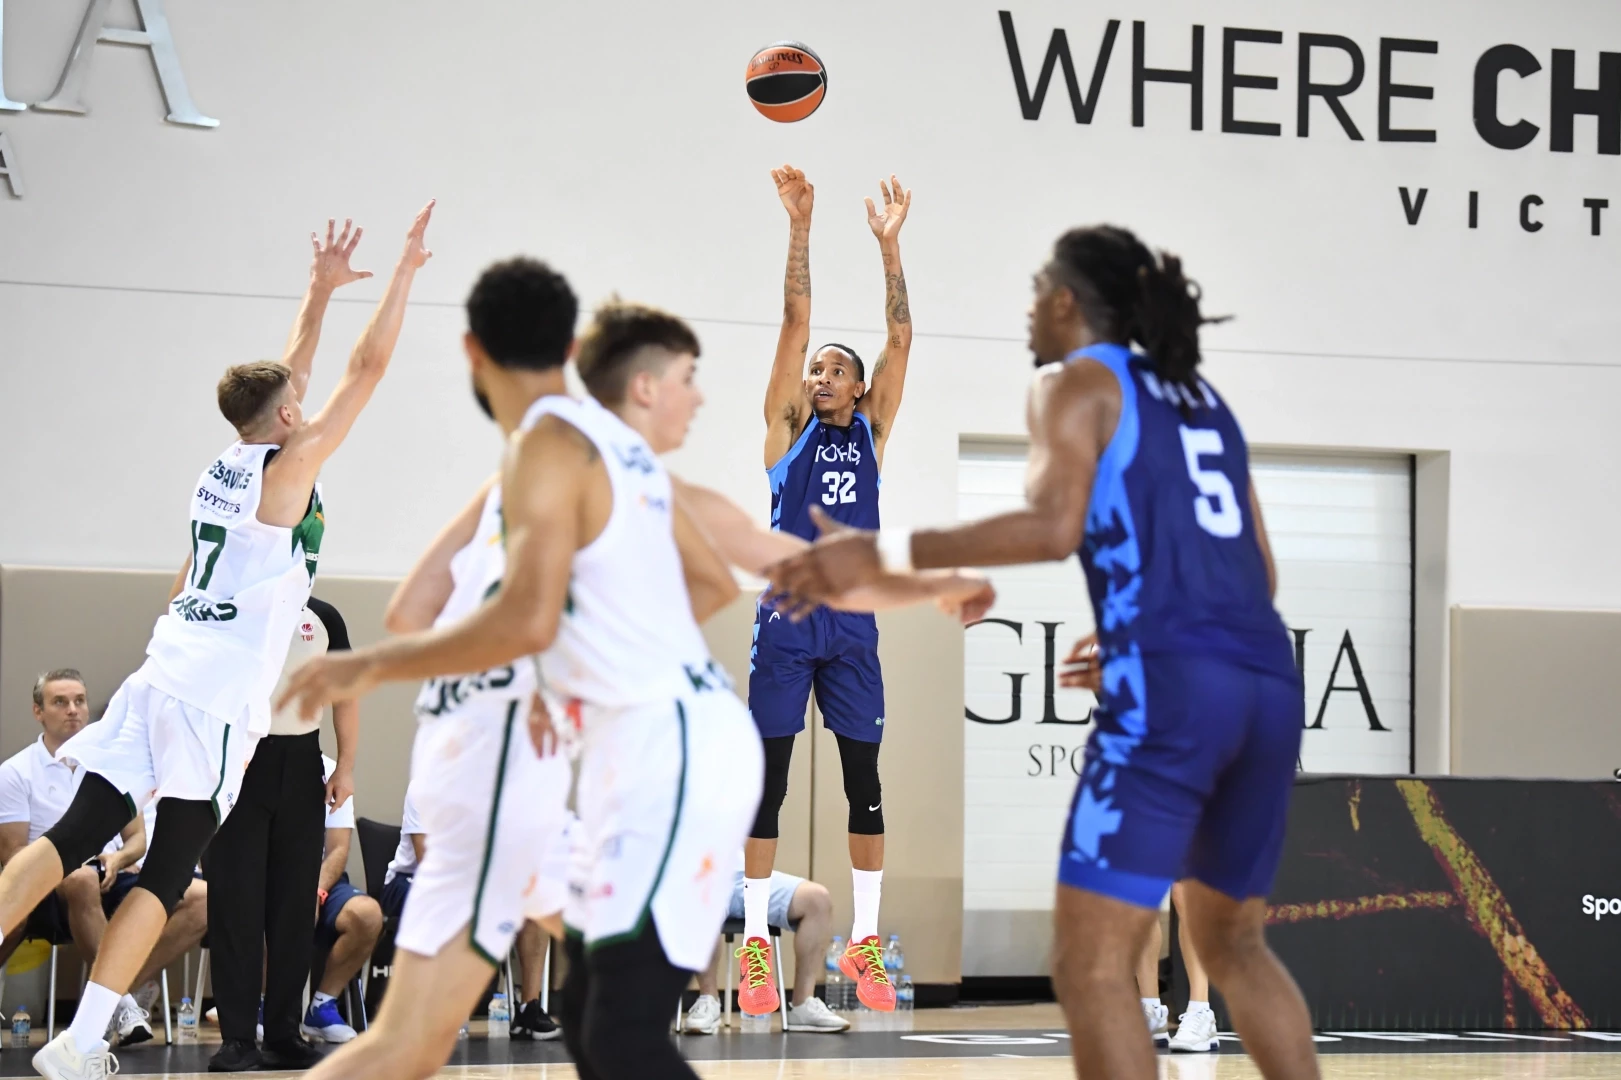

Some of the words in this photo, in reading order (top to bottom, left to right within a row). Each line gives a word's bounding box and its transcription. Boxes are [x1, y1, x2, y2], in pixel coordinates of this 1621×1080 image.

[998, 10, 1438, 143] WHERE
[1473, 43, 1621, 155] CH
[1398, 186, 1609, 236] VICT
[821, 471, 857, 506] 32
[1179, 424, 1243, 539] 5
[190, 519, 227, 591] 17
[964, 618, 1392, 732] GLIA
